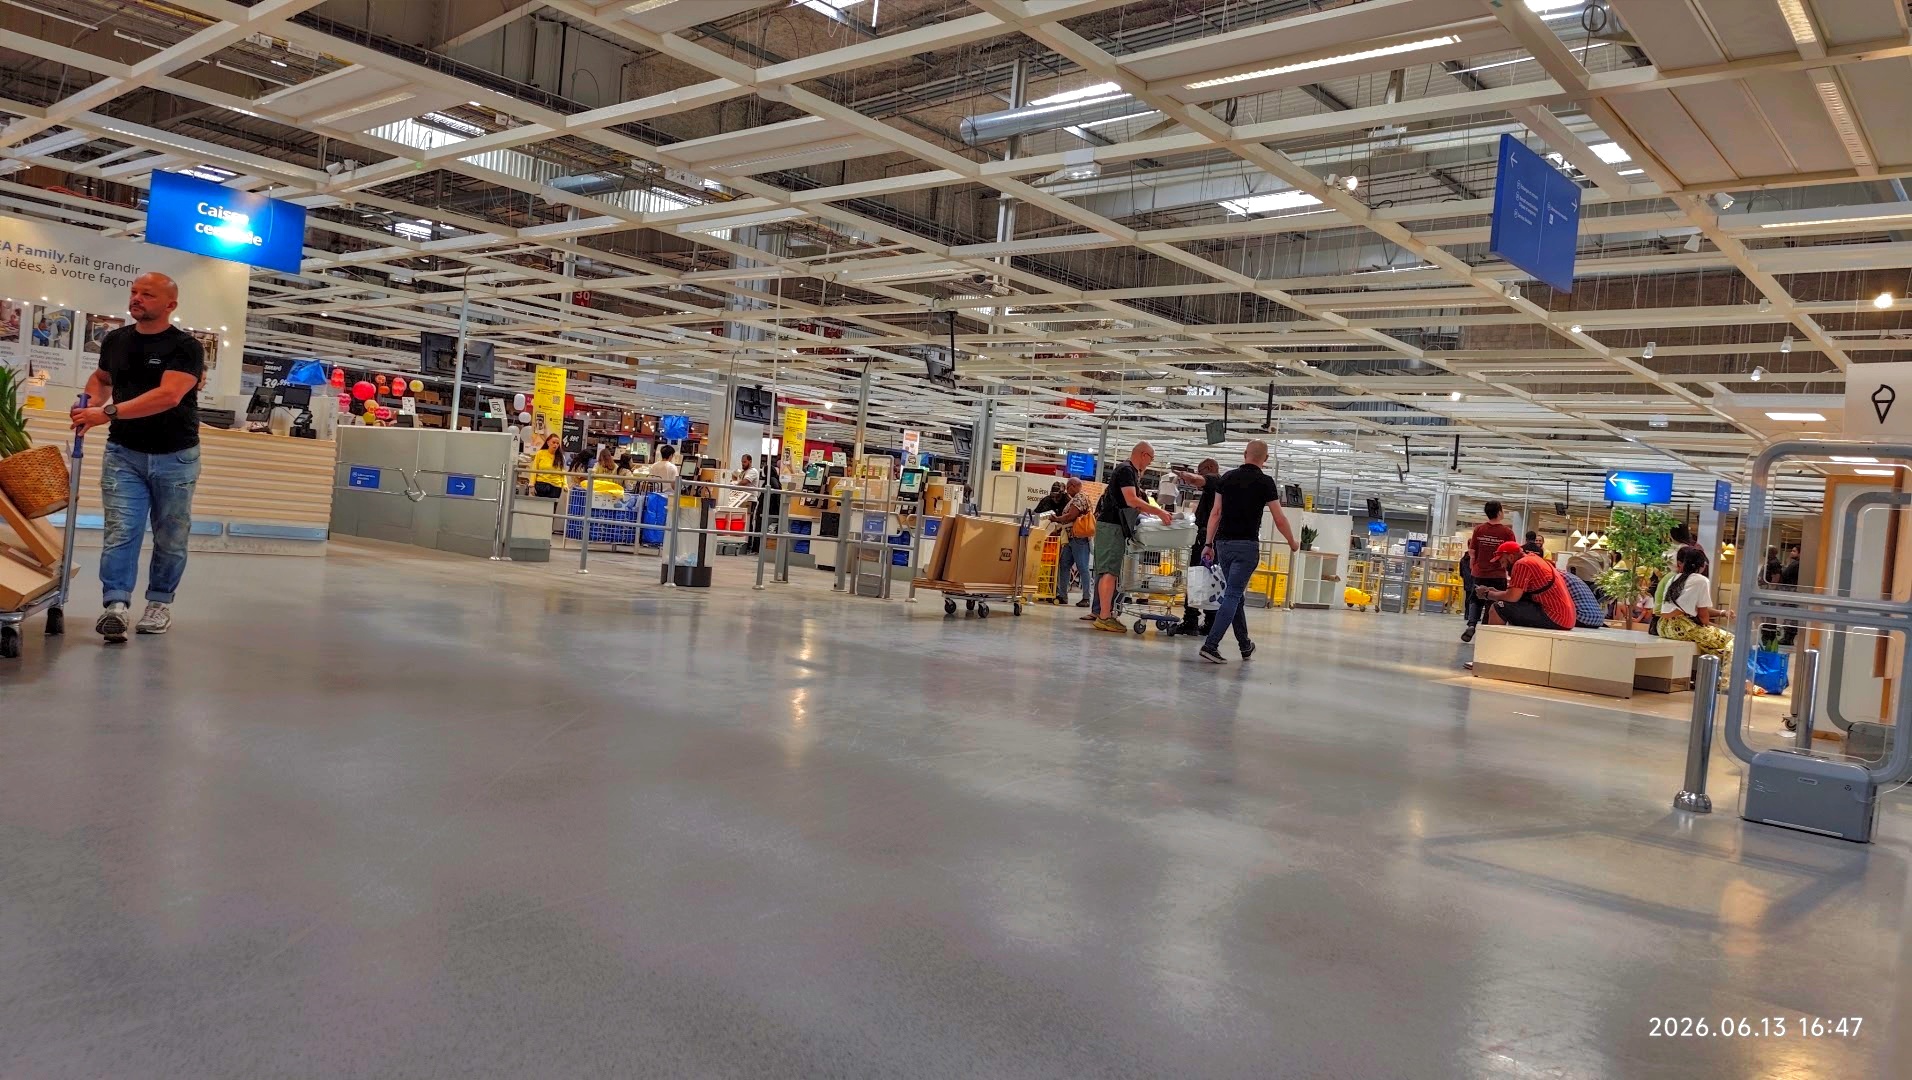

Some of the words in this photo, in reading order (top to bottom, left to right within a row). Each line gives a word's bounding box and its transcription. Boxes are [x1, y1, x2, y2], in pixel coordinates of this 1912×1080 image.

[197, 202, 249, 223] Cais
[6, 257, 45, 274] idées,
[50, 265, 58, 275] à
[62, 268, 95, 281] votre
[69, 252, 90, 266] fait
[94, 259, 140, 275] grandir
